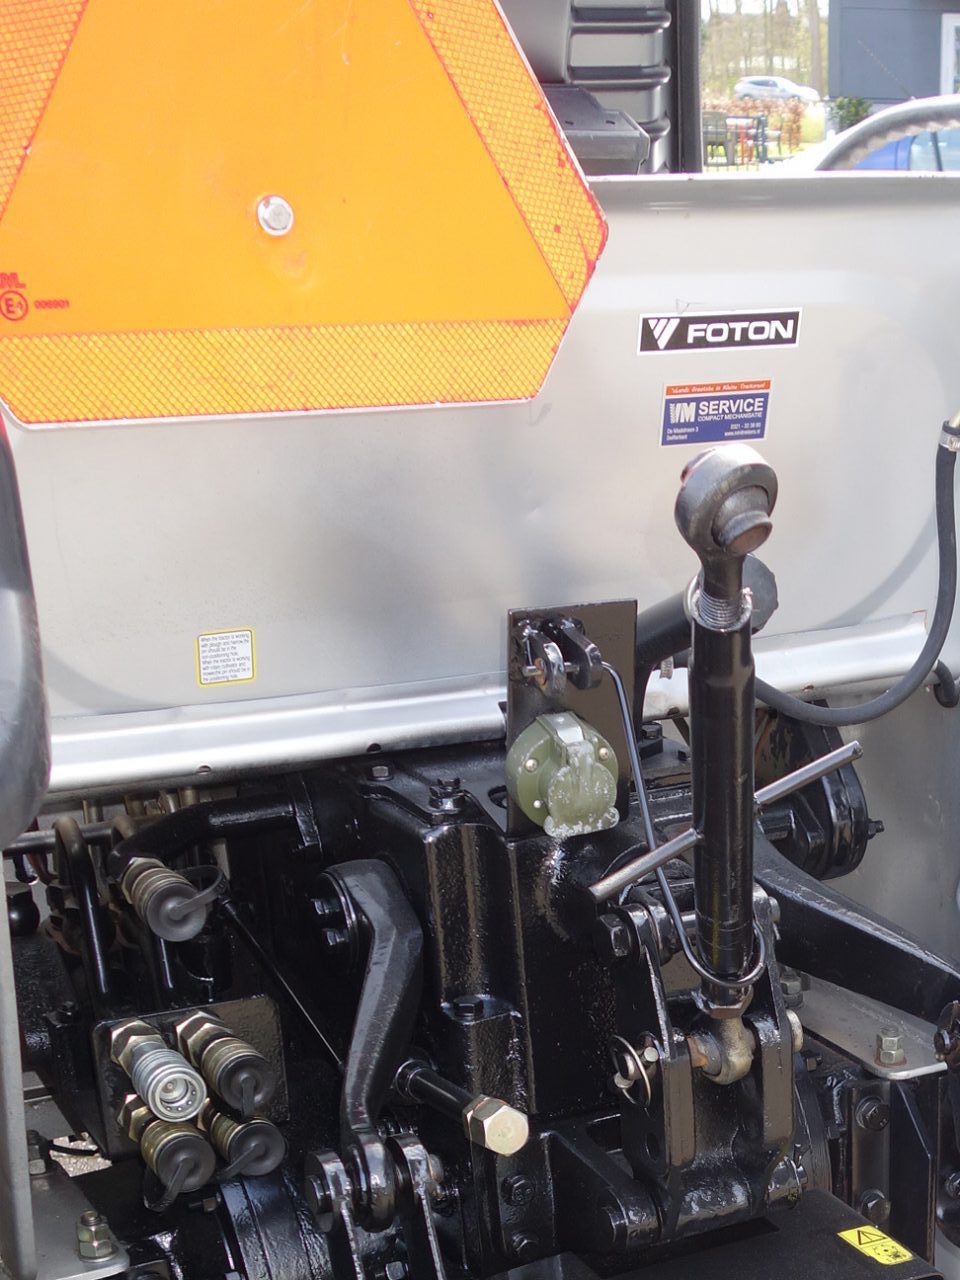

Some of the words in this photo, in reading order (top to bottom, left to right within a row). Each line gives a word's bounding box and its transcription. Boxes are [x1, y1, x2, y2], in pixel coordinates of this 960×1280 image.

[687, 319, 794, 344] FOTON
[698, 398, 764, 415] SERVICE
[697, 414, 725, 422] COMPACT
[724, 411, 763, 420] MECHANISATIE
